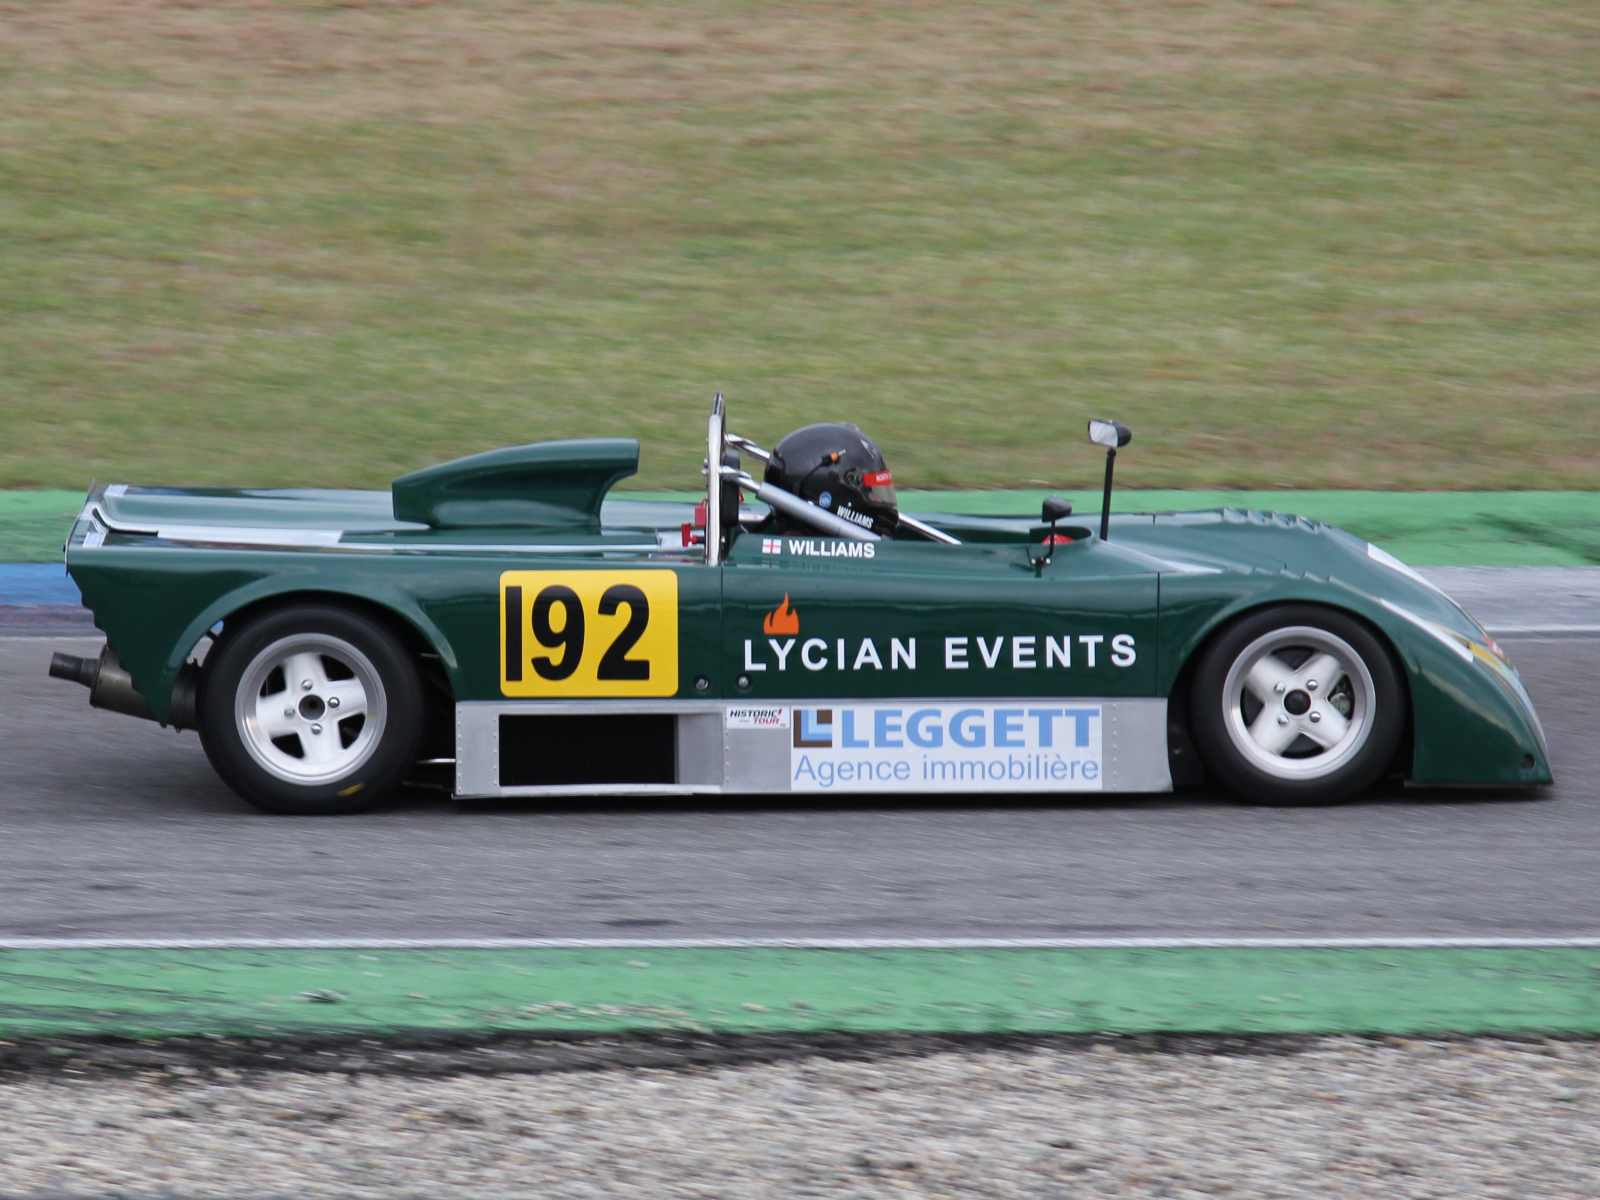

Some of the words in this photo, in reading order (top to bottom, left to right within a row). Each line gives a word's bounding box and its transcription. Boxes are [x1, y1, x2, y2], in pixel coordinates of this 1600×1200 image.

[837, 504, 874, 529] WILLIAMS
[789, 540, 876, 558] WILLIAMS
[506, 584, 650, 682] 192
[745, 637, 916, 670] LYCIAN
[945, 634, 1136, 669] EVENTS
[754, 717, 779, 725] TOUR
[841, 708, 1100, 749] LEGGETT
[794, 755, 911, 788] Agence
[922, 754, 1099, 781] immobilière
